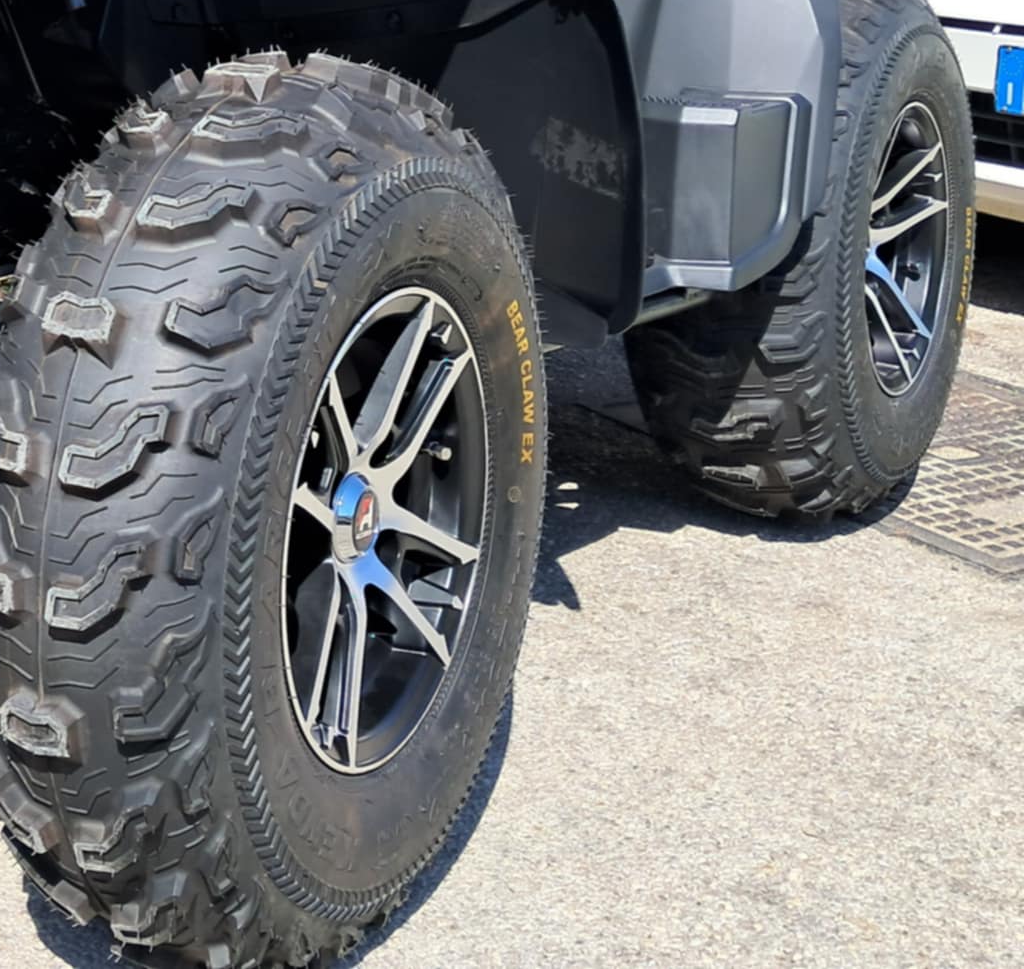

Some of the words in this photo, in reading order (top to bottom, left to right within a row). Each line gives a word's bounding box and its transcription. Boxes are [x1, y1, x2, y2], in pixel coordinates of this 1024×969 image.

[506, 299, 529, 356] BEAR
[520, 360, 536, 424] CLAW
[520, 432, 534, 463] EX
